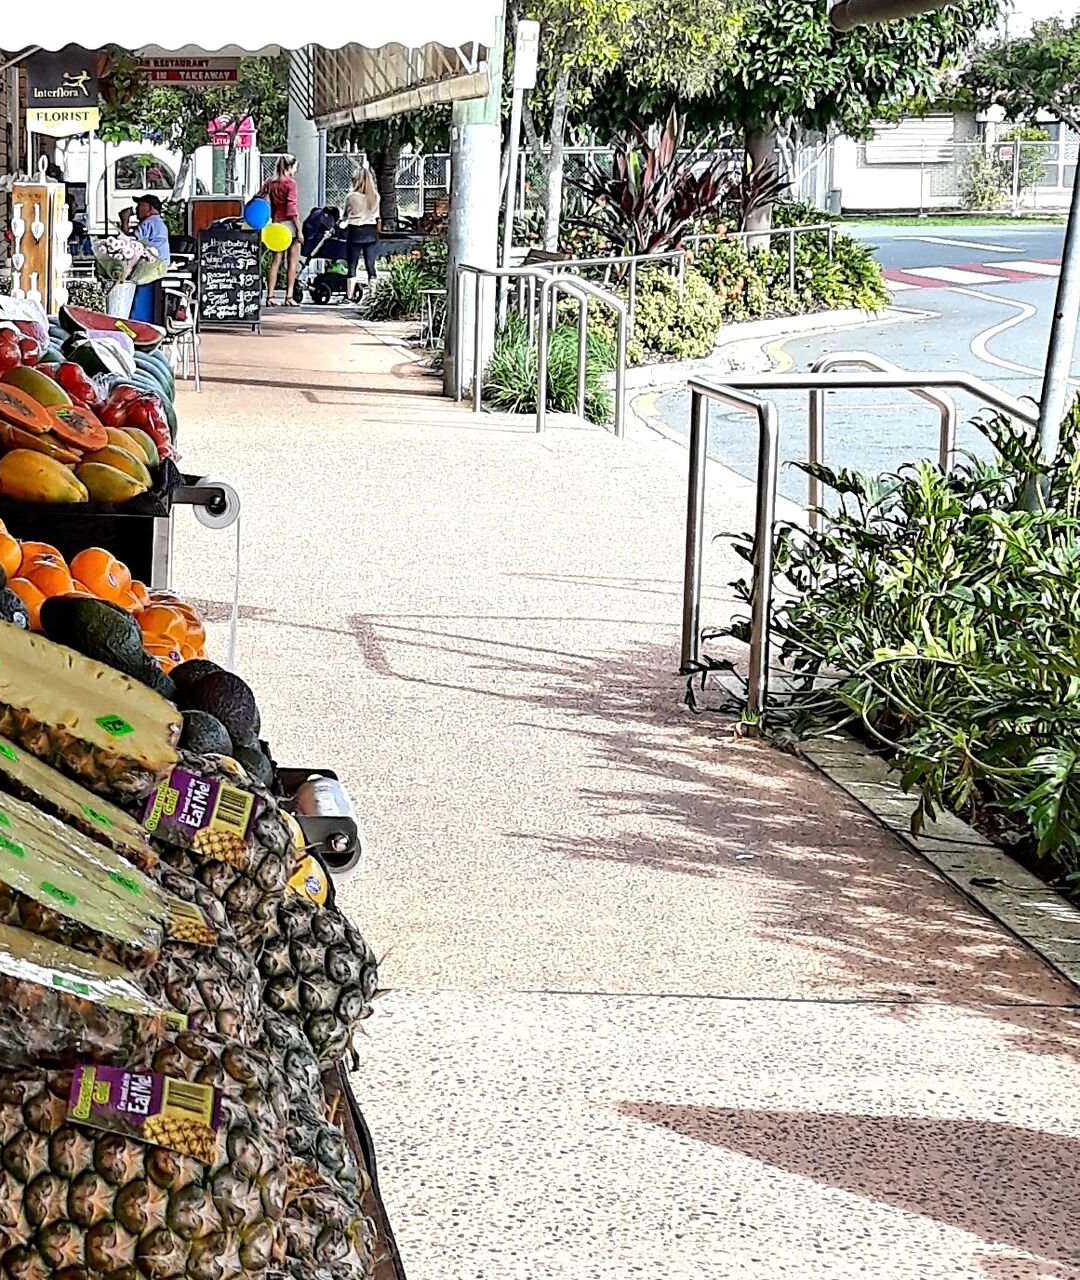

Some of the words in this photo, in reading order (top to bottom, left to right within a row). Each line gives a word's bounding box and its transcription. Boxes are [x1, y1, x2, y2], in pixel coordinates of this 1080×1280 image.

[154, 59, 210, 69] RESTAURANT
[179, 71, 231, 80] TAKEAWAY
[33, 86, 79, 98] Interflora
[36, 111, 90, 122] FLORIST
[192, 780, 211, 805] Me!
[186, 800, 207, 828] Eat
[131, 1073, 152, 1095] Me!
[128, 1092, 151, 1115] Eat
